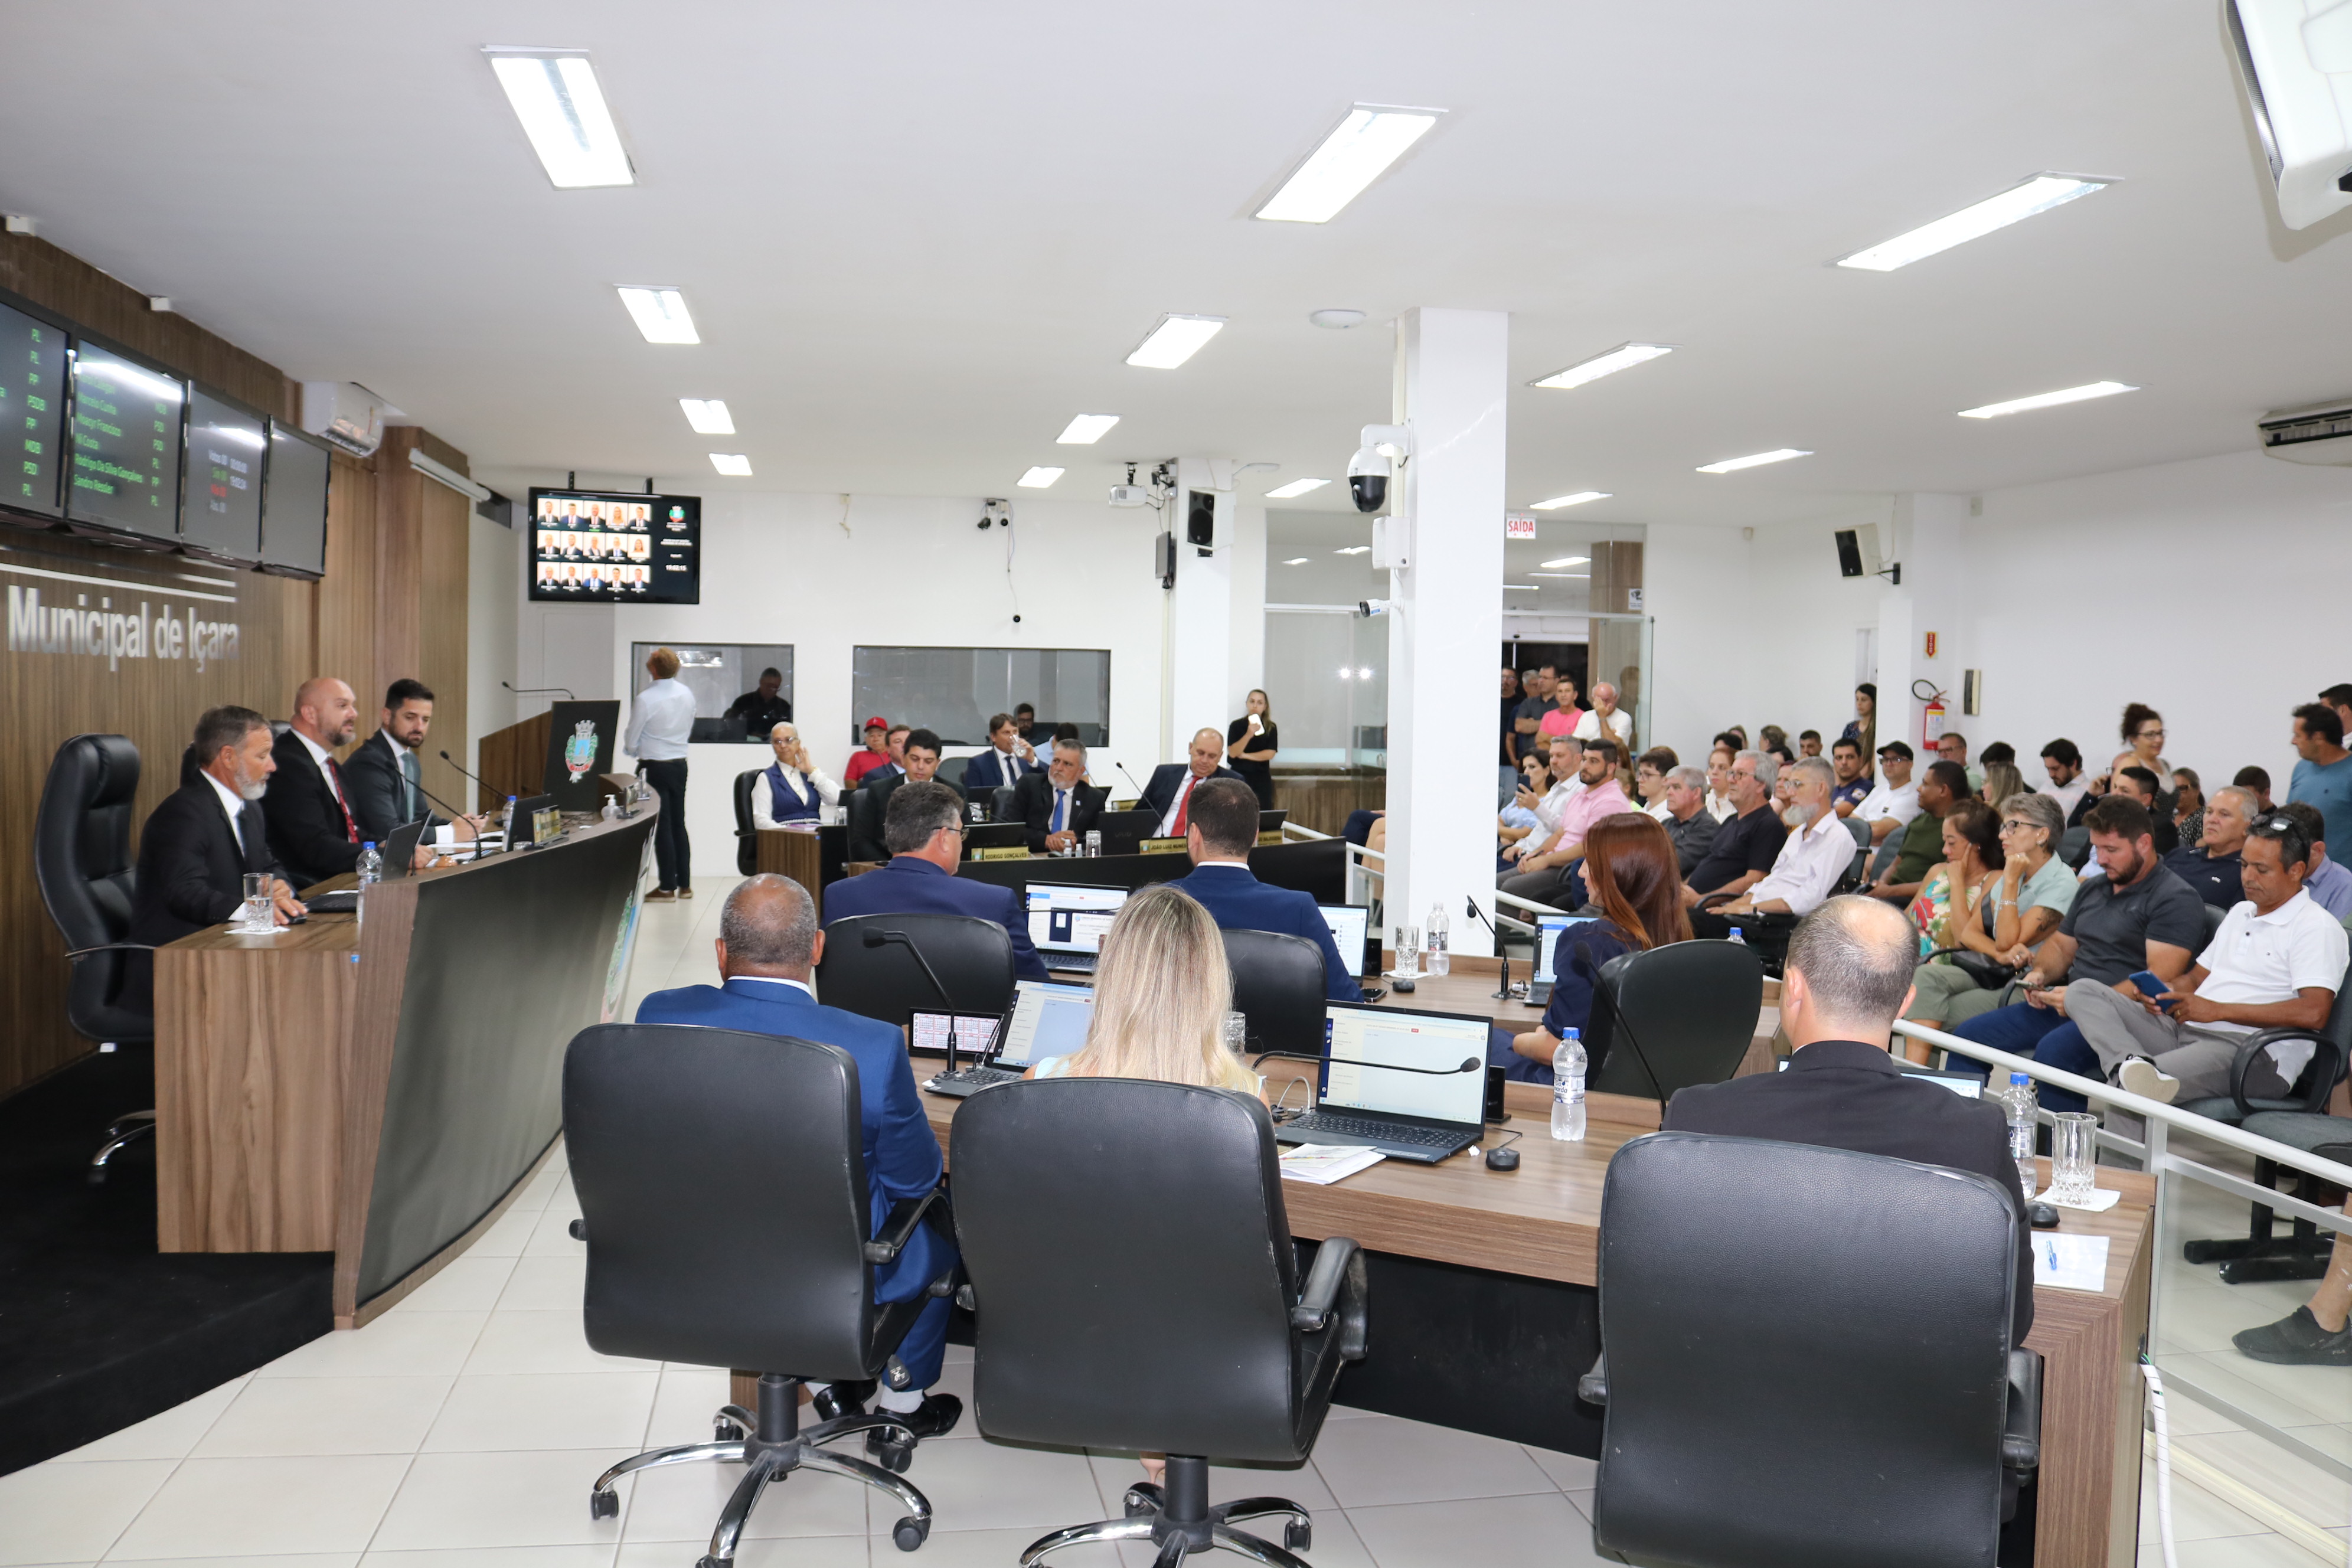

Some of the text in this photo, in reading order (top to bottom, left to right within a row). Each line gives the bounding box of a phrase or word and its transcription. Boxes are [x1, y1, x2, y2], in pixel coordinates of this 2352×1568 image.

[31, 328, 41, 342] PL
[30, 351, 40, 364] PL
[28, 373, 39, 386] PP
[25, 417, 37, 430] PP
[22, 483, 32, 496] PL
[1508, 518, 1534, 533] SAÍDA
[8, 585, 239, 672] Municipal de Içara
